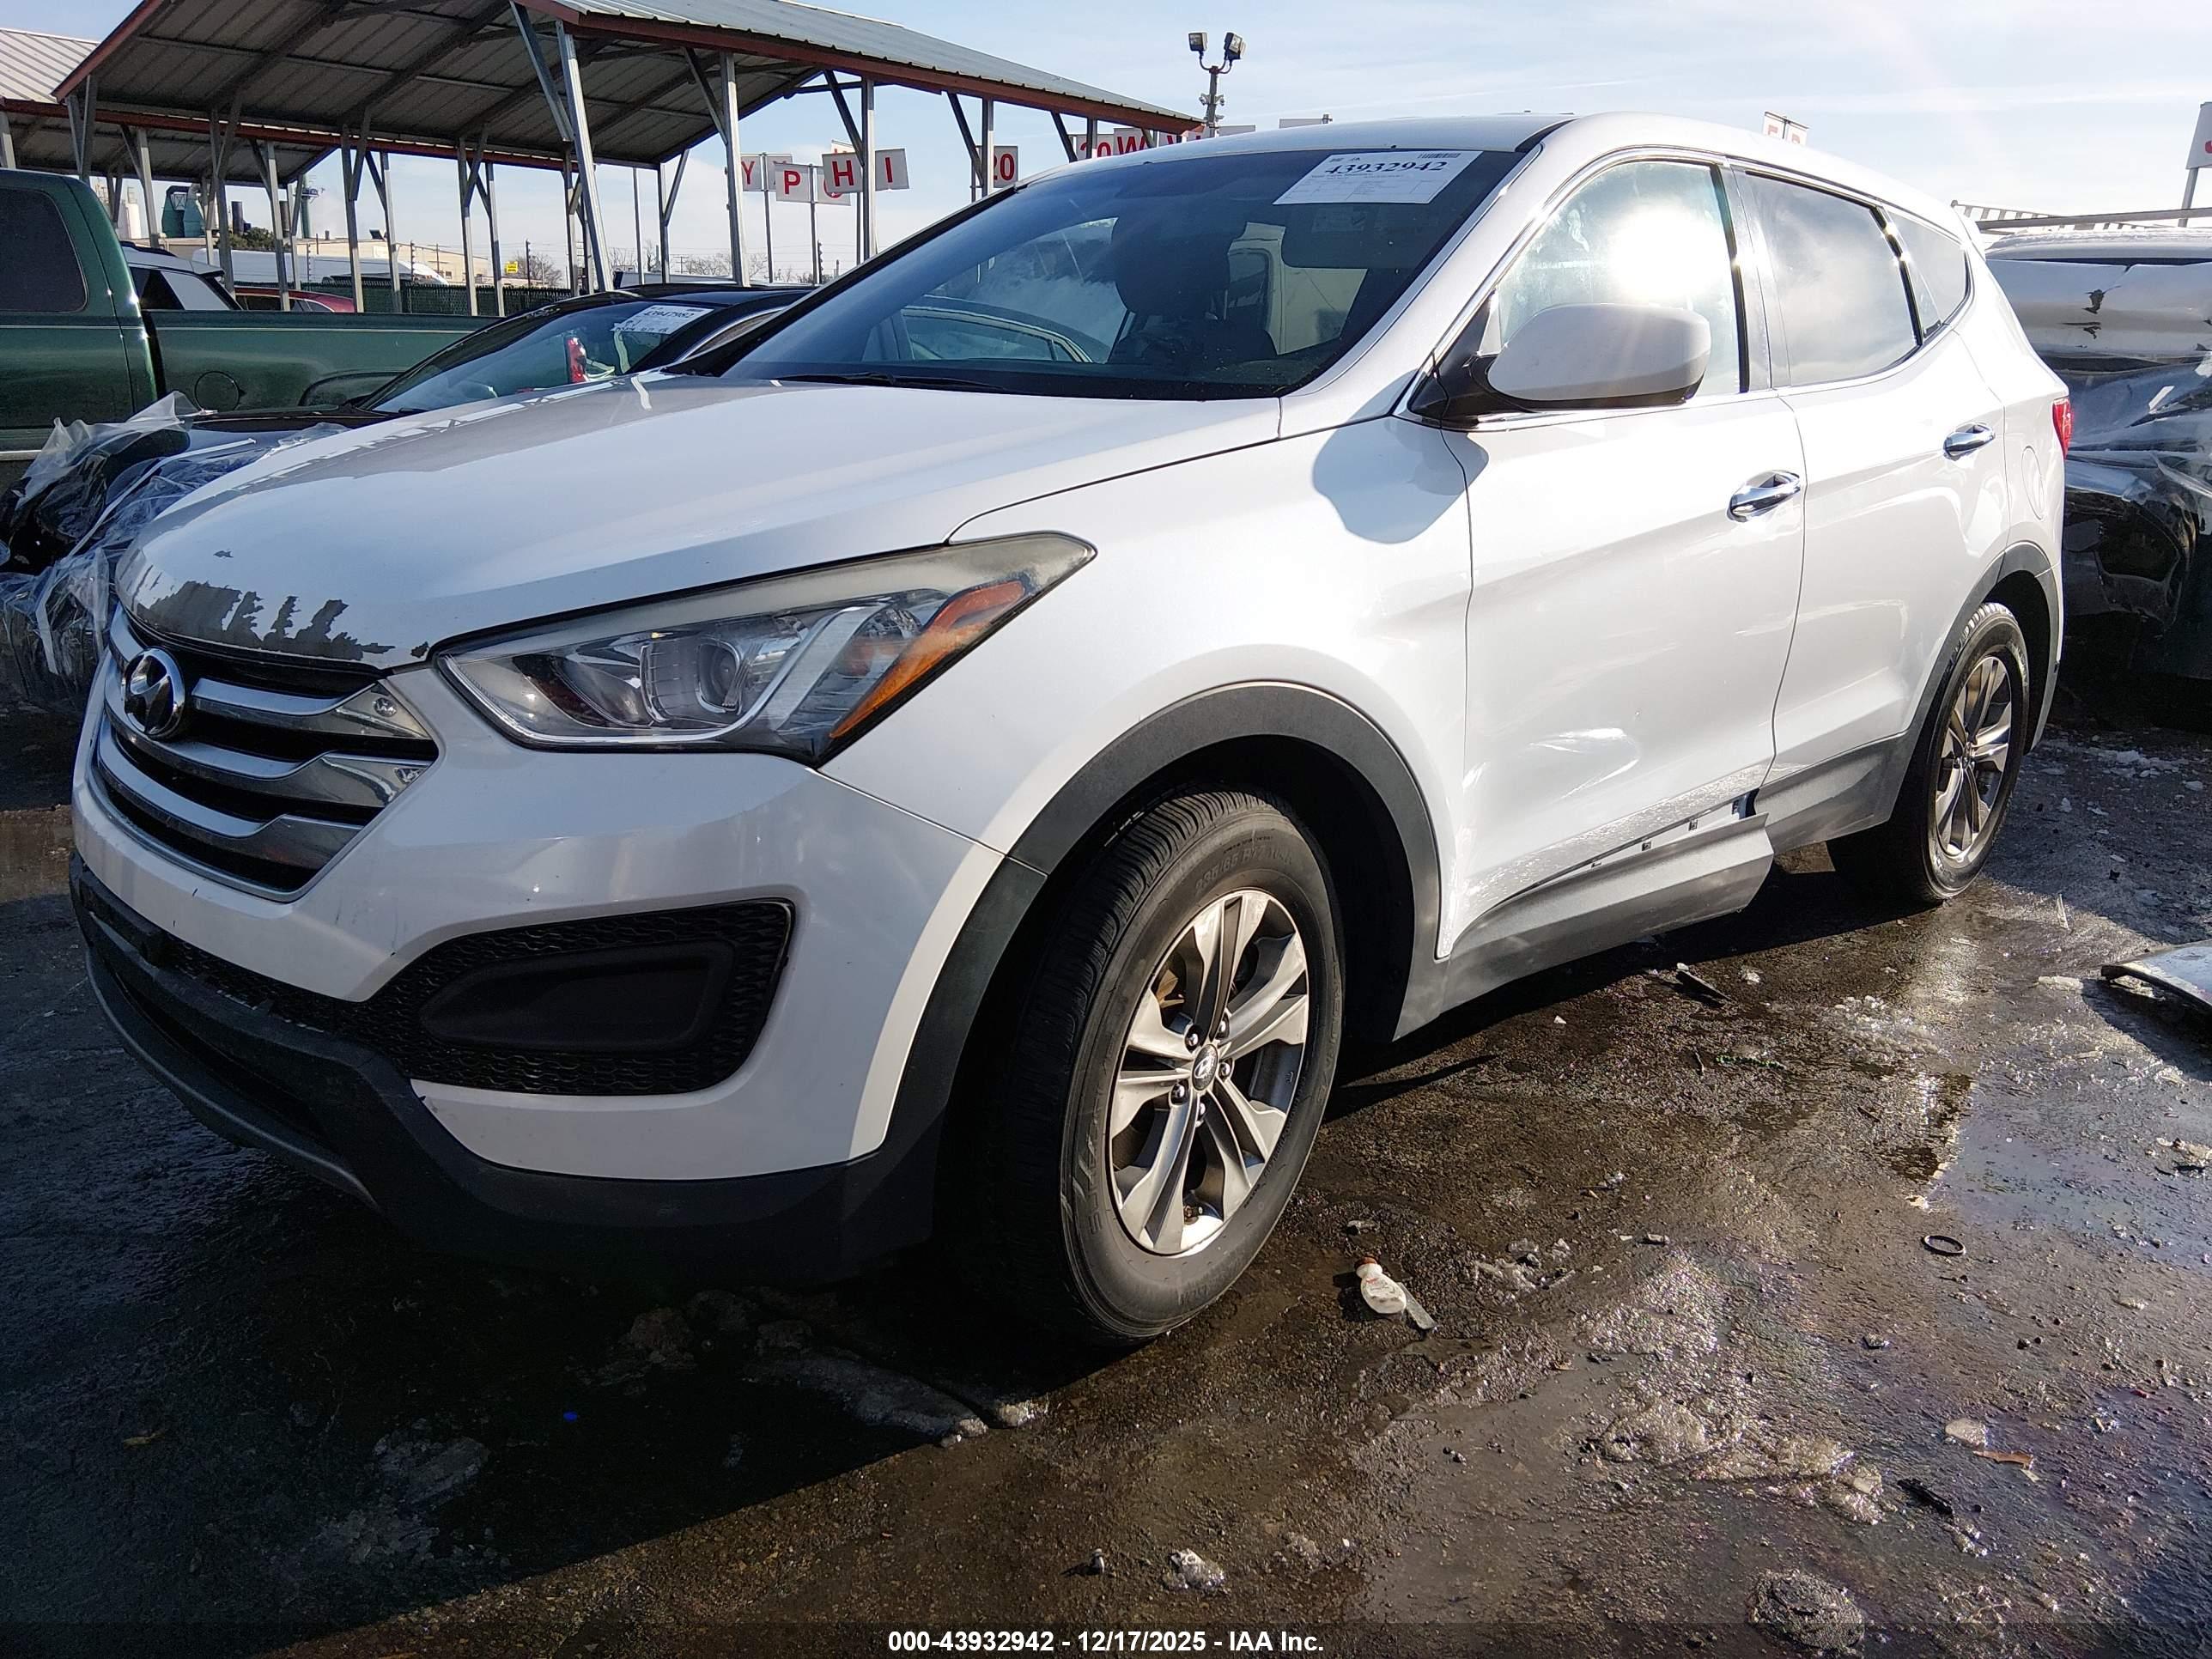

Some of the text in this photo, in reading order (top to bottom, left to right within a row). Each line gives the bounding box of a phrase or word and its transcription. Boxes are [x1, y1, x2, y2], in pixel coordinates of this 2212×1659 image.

[741, 161, 755, 185] Y
[832, 160, 854, 187] H
[1325, 161, 1448, 174] 43932942
[784, 170, 801, 194] P
